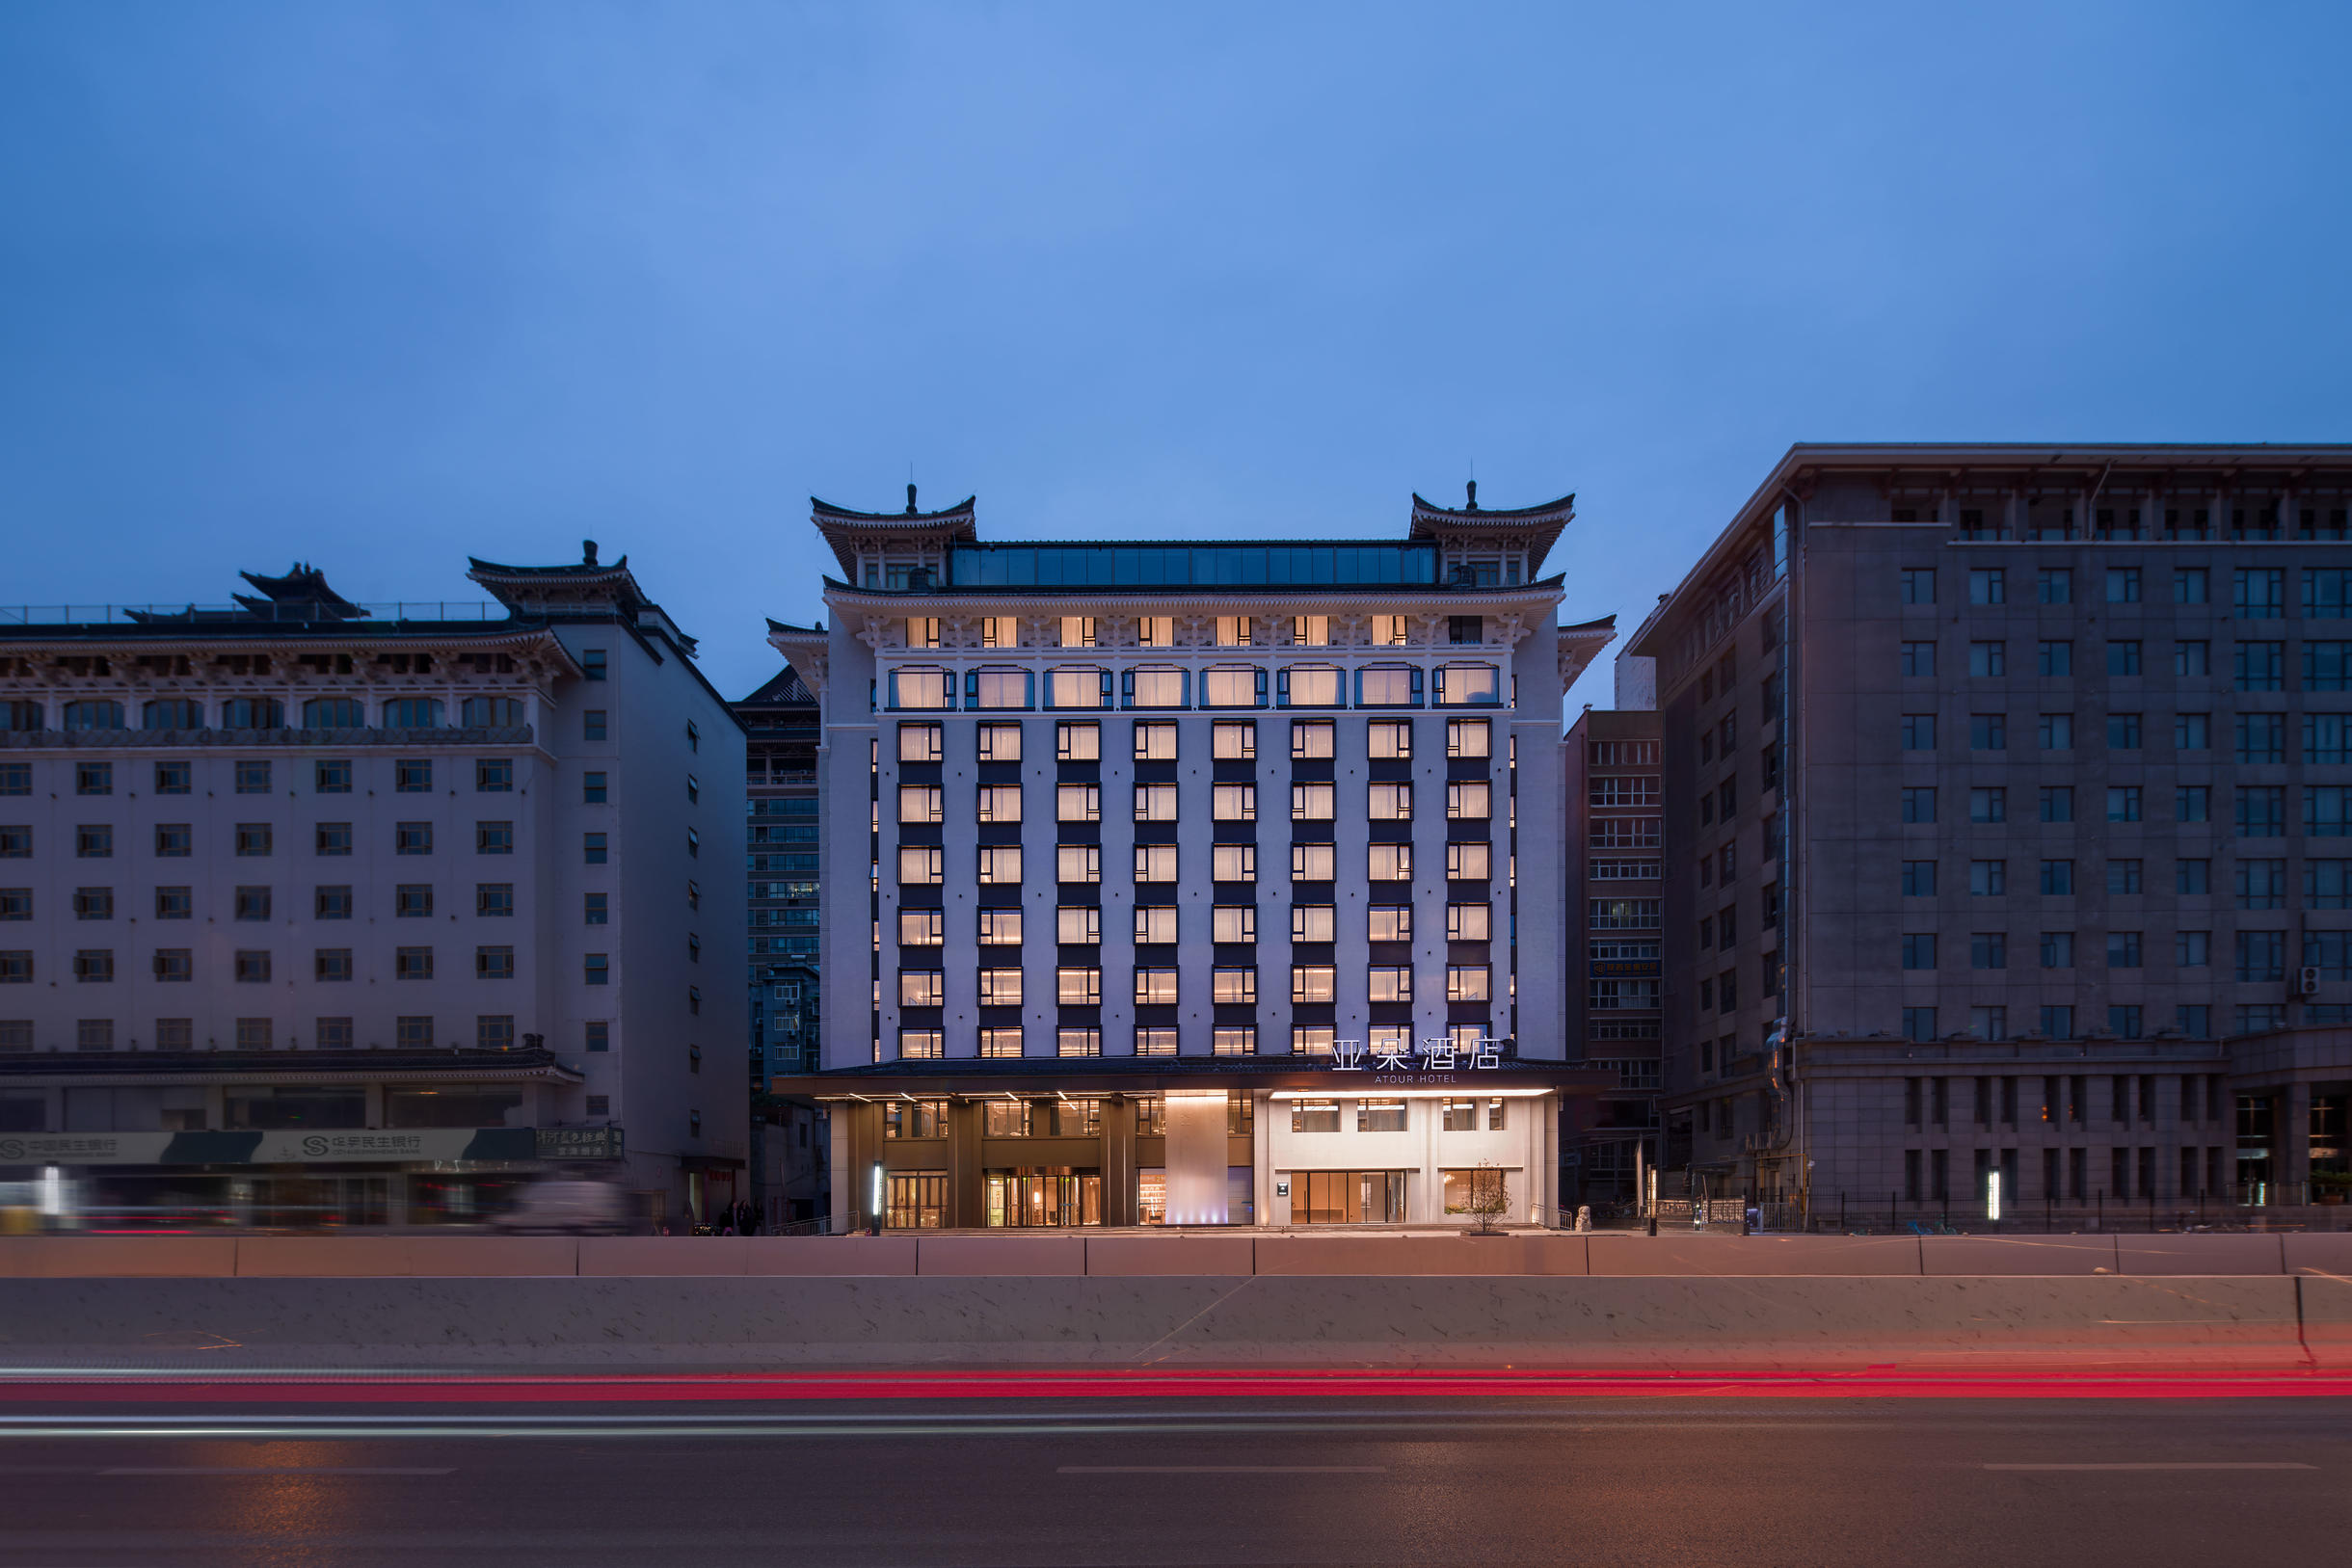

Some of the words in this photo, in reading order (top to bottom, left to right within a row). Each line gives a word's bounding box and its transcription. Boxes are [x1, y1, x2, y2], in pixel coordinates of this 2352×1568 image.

[1332, 1035, 1501, 1071] 亚朵酒店
[1375, 1075, 1414, 1083] ATOUR
[1420, 1075, 1457, 1083] HOTEL
